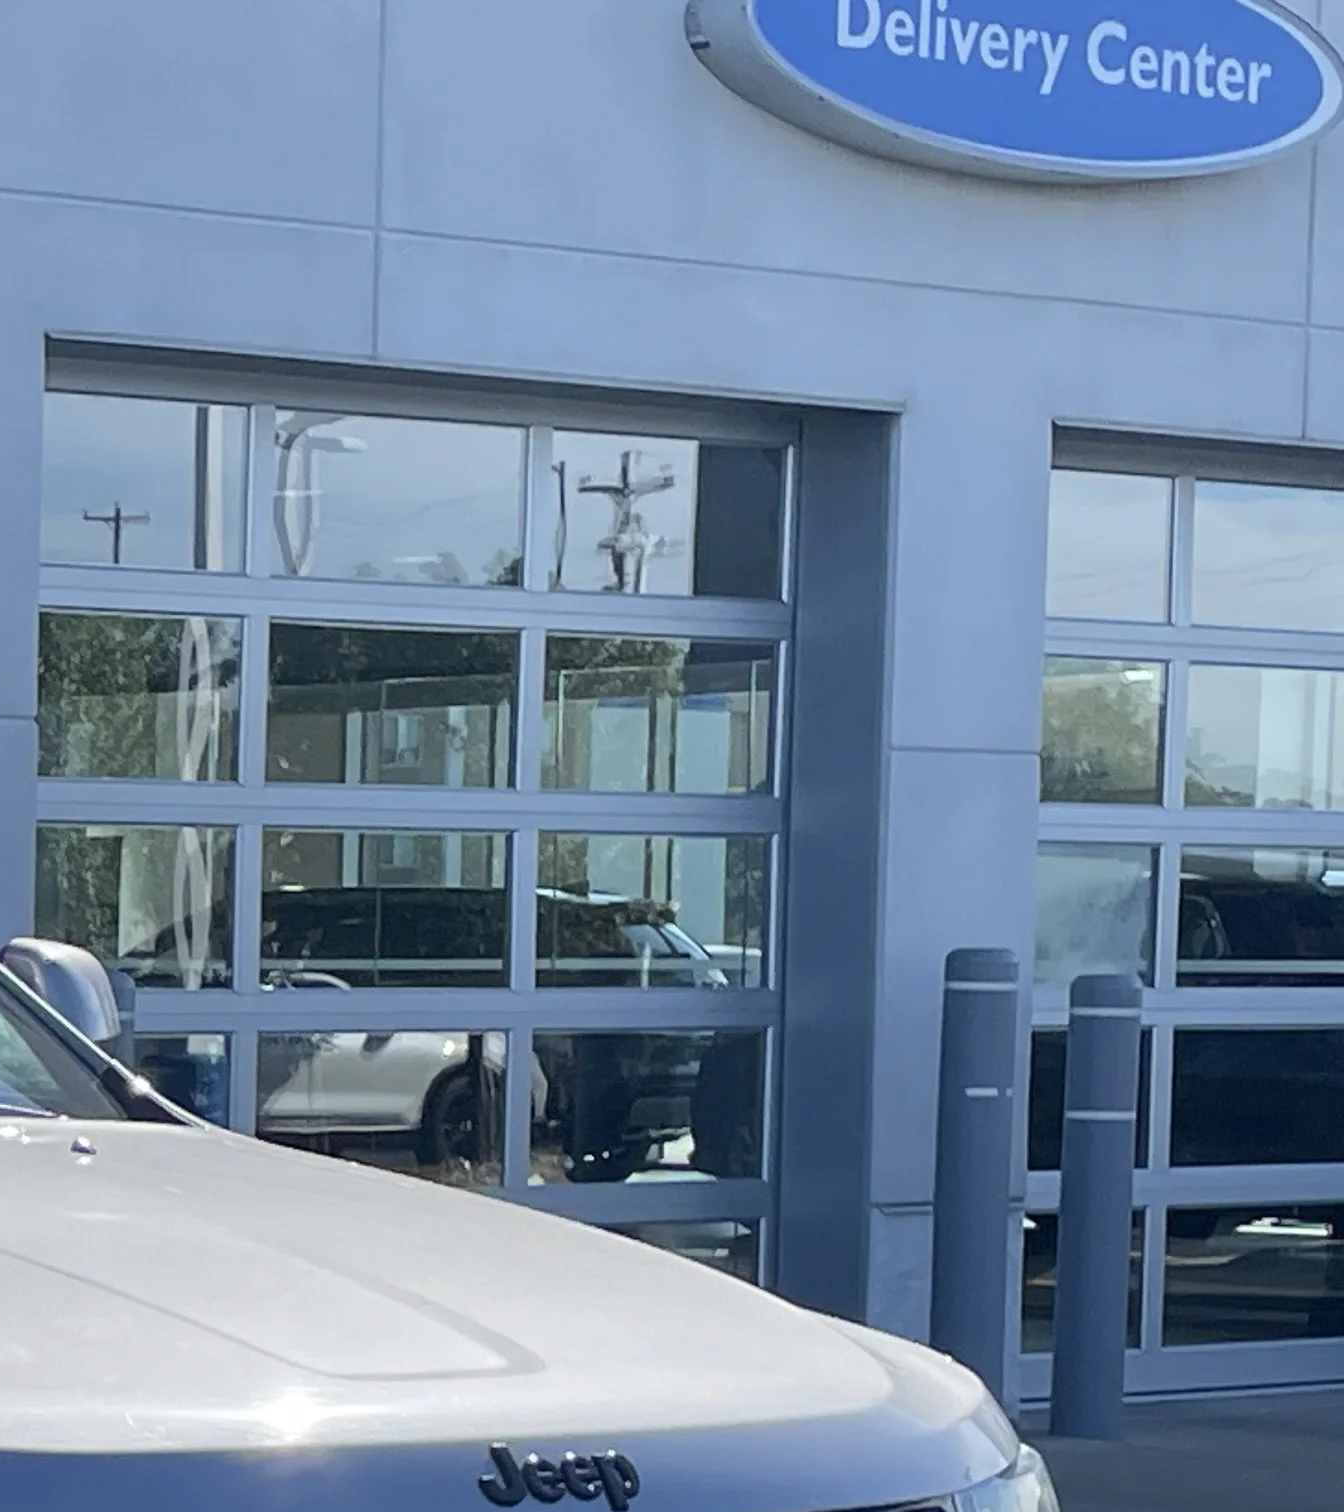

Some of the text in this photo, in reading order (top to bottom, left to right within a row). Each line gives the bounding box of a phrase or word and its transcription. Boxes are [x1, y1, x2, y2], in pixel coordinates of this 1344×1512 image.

[836, 0, 1272, 104] Delivery Center
[477, 1441, 641, 1512] Jeep
